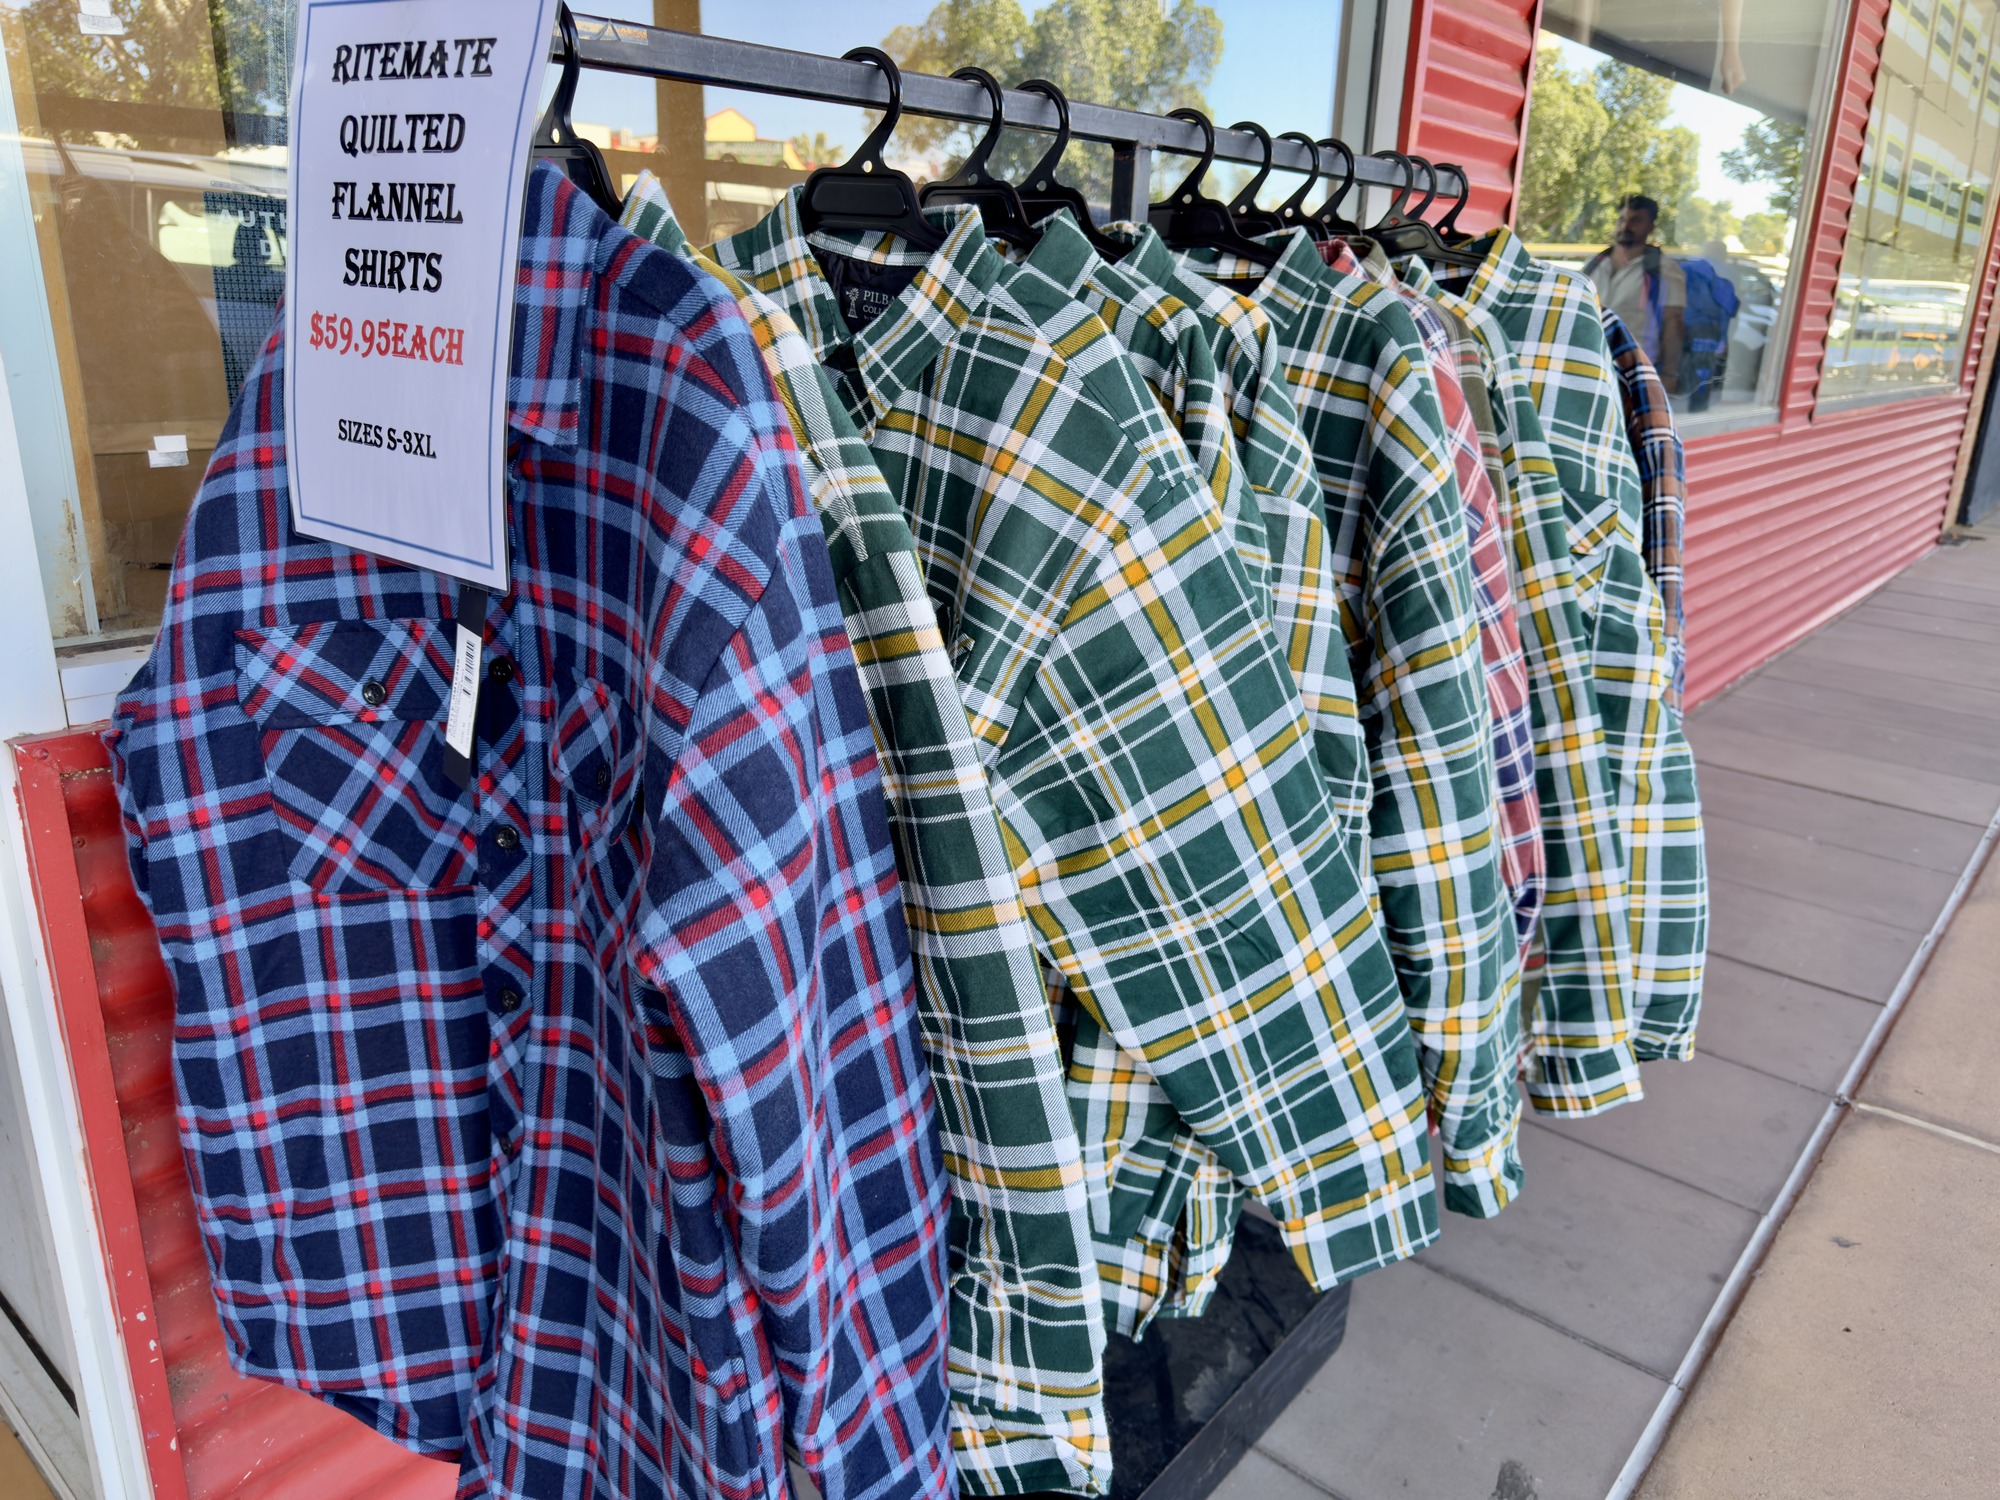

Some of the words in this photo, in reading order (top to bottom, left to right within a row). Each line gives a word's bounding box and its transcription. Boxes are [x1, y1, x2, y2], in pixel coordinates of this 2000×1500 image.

[332, 38, 497, 85] RITEMATE
[340, 113, 466, 158] QUILTED
[332, 182, 463, 224] FLANNEL
[343, 247, 443, 293] SHIRTS
[309, 310, 465, 365] $59.95EACH
[338, 418, 383, 449] SIZES
[387, 427, 437, 460] S-3XL
